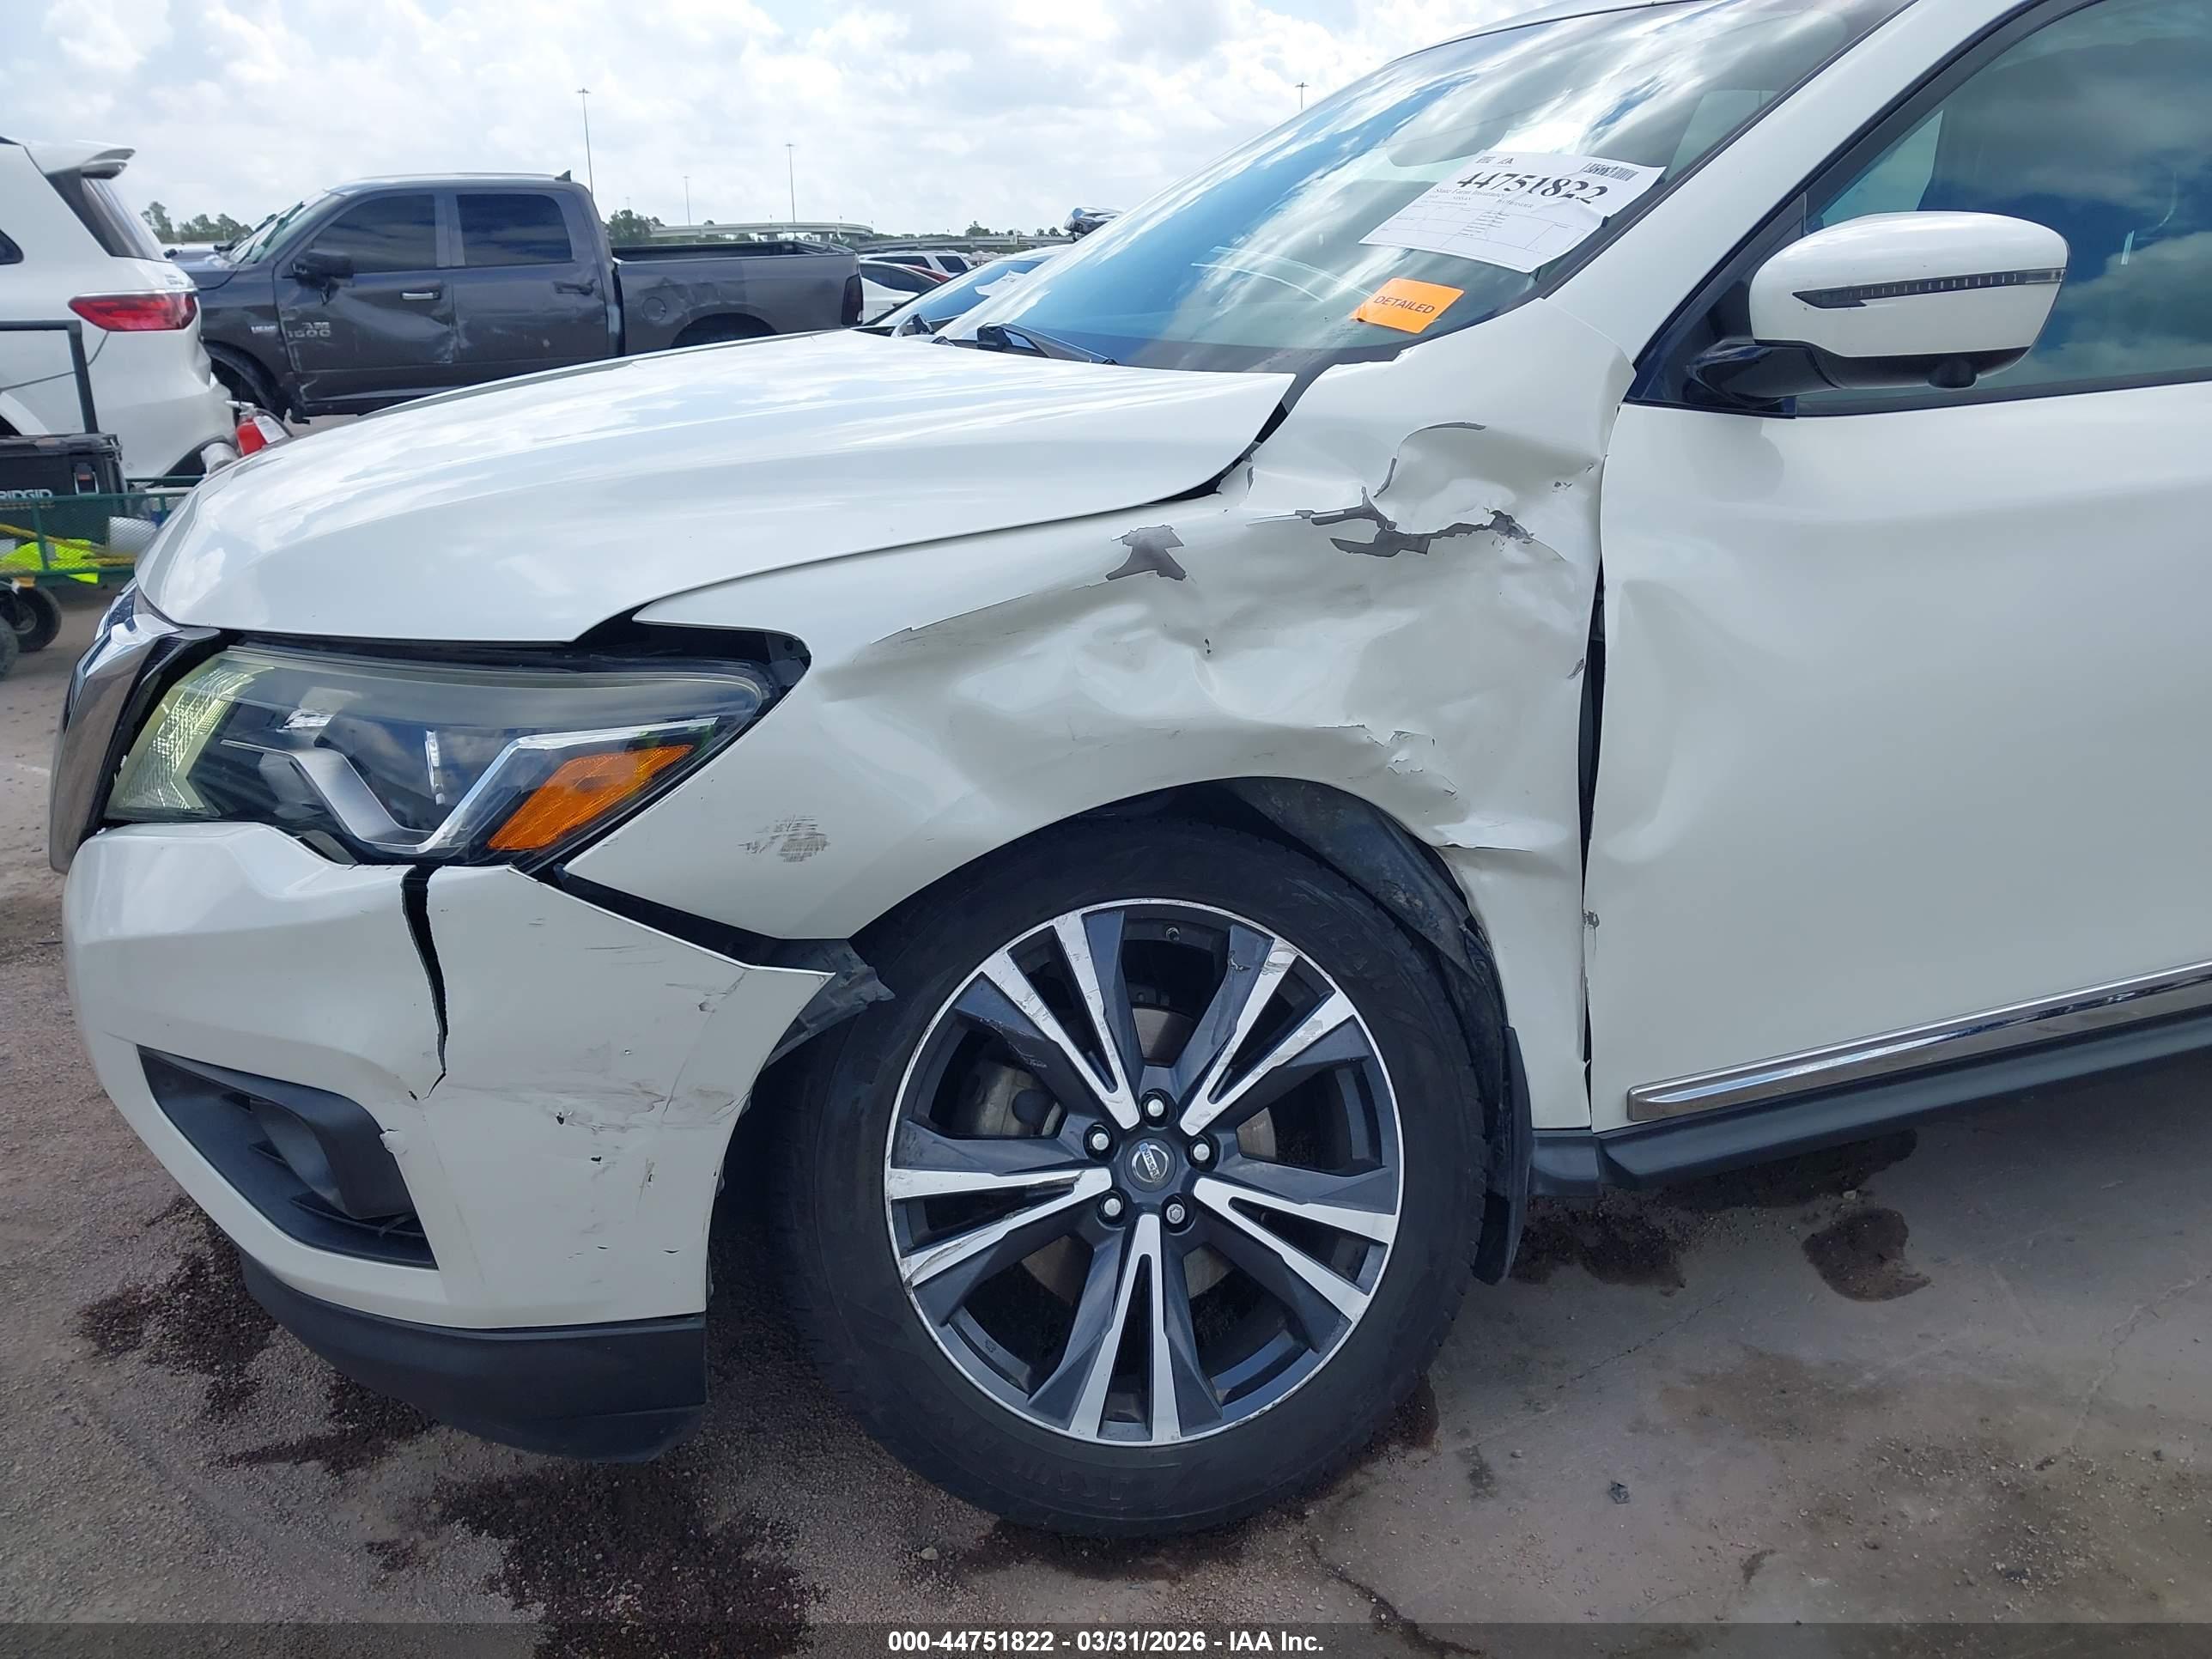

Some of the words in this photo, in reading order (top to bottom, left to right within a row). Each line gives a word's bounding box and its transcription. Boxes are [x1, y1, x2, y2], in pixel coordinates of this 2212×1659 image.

[1456, 171, 1608, 204] 44751822
[1373, 295, 1435, 314] DETAILED
[1144, 1150, 1161, 1182] NISSAN
